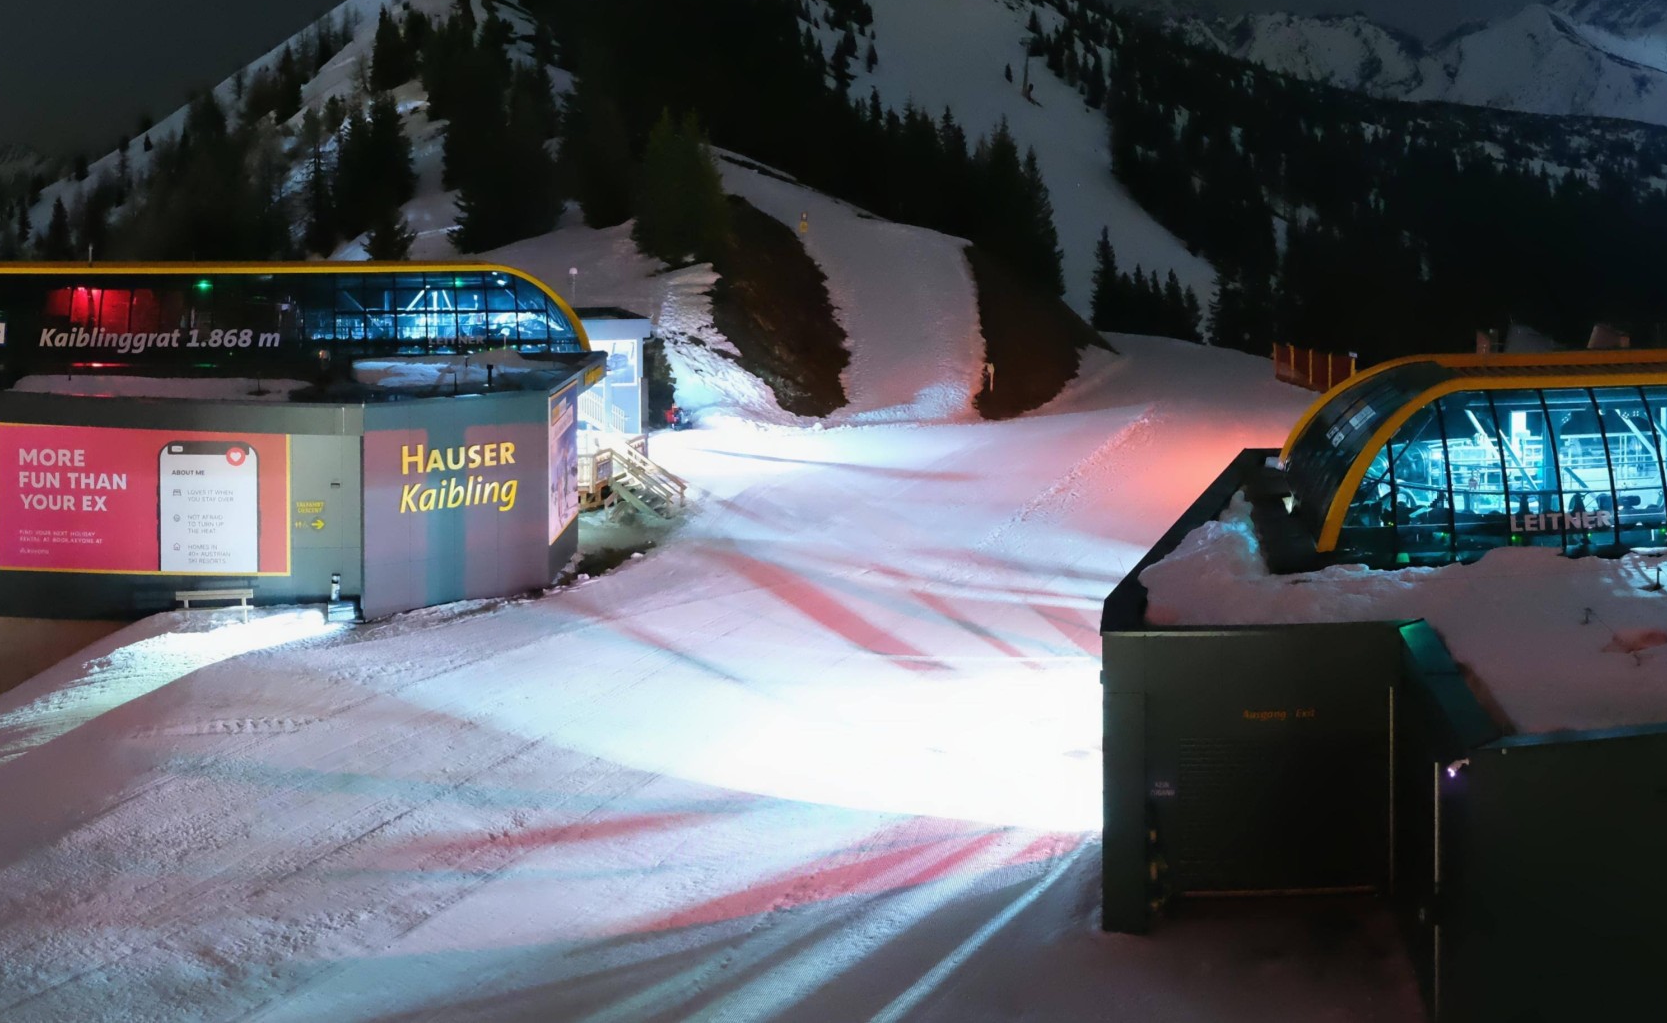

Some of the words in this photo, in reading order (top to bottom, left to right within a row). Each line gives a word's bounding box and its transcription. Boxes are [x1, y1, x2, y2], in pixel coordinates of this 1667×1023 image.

[39, 328, 180, 354] Kaiblinggrat
[186, 329, 253, 348] 1.868
[258, 332, 281, 348] m
[428, 336, 485, 345] LEITNER
[18, 448, 85, 467] MORE
[401, 442, 516, 475] HAUSER
[19, 471, 60, 488] FUN
[67, 472, 127, 490] THAN
[20, 493, 76, 511] YOUR
[82, 495, 107, 512] EX
[400, 475, 518, 514] Kaibling
[1510, 510, 1612, 532] LEITNER
